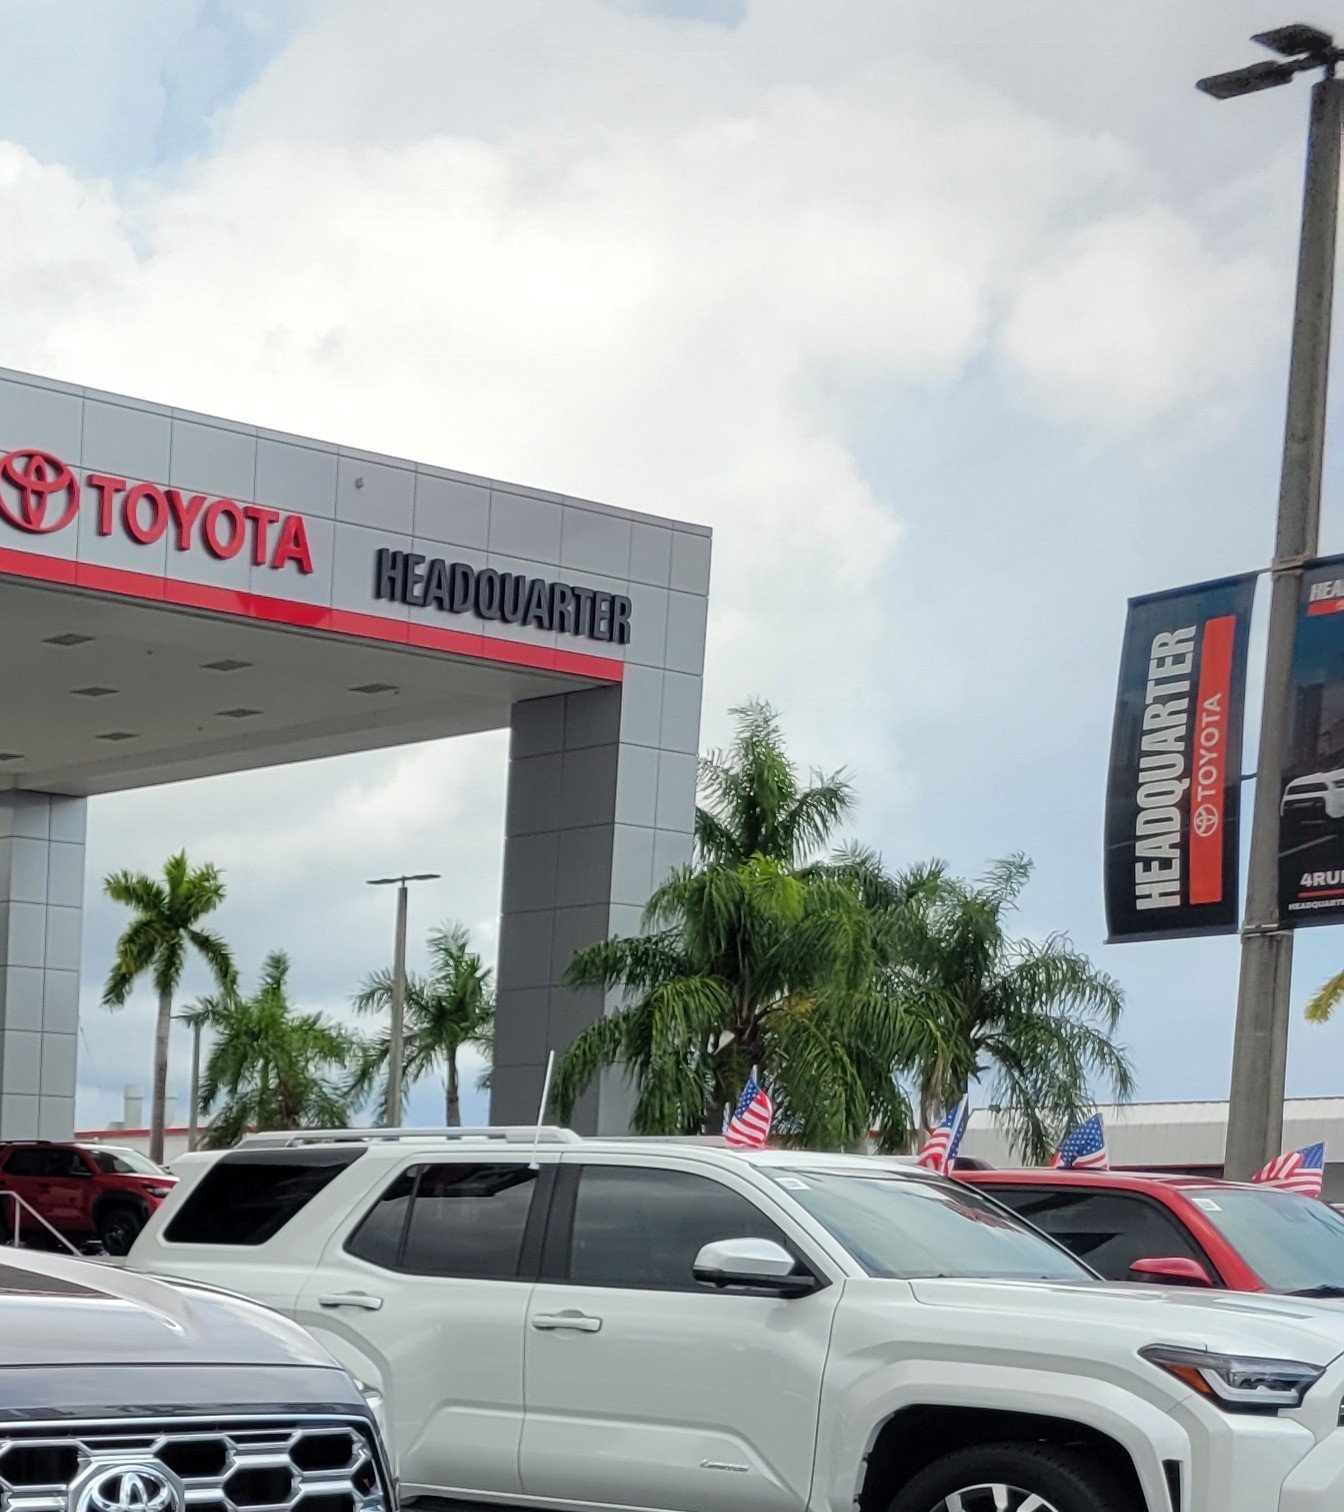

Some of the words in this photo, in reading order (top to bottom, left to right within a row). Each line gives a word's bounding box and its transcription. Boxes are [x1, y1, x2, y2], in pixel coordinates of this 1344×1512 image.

[87, 474, 314, 574] TOYOTA
[374, 547, 633, 645] HEADQUARTER
[1135, 624, 1197, 911] HEADQUARTER
[1197, 692, 1222, 802] TOYOTA
